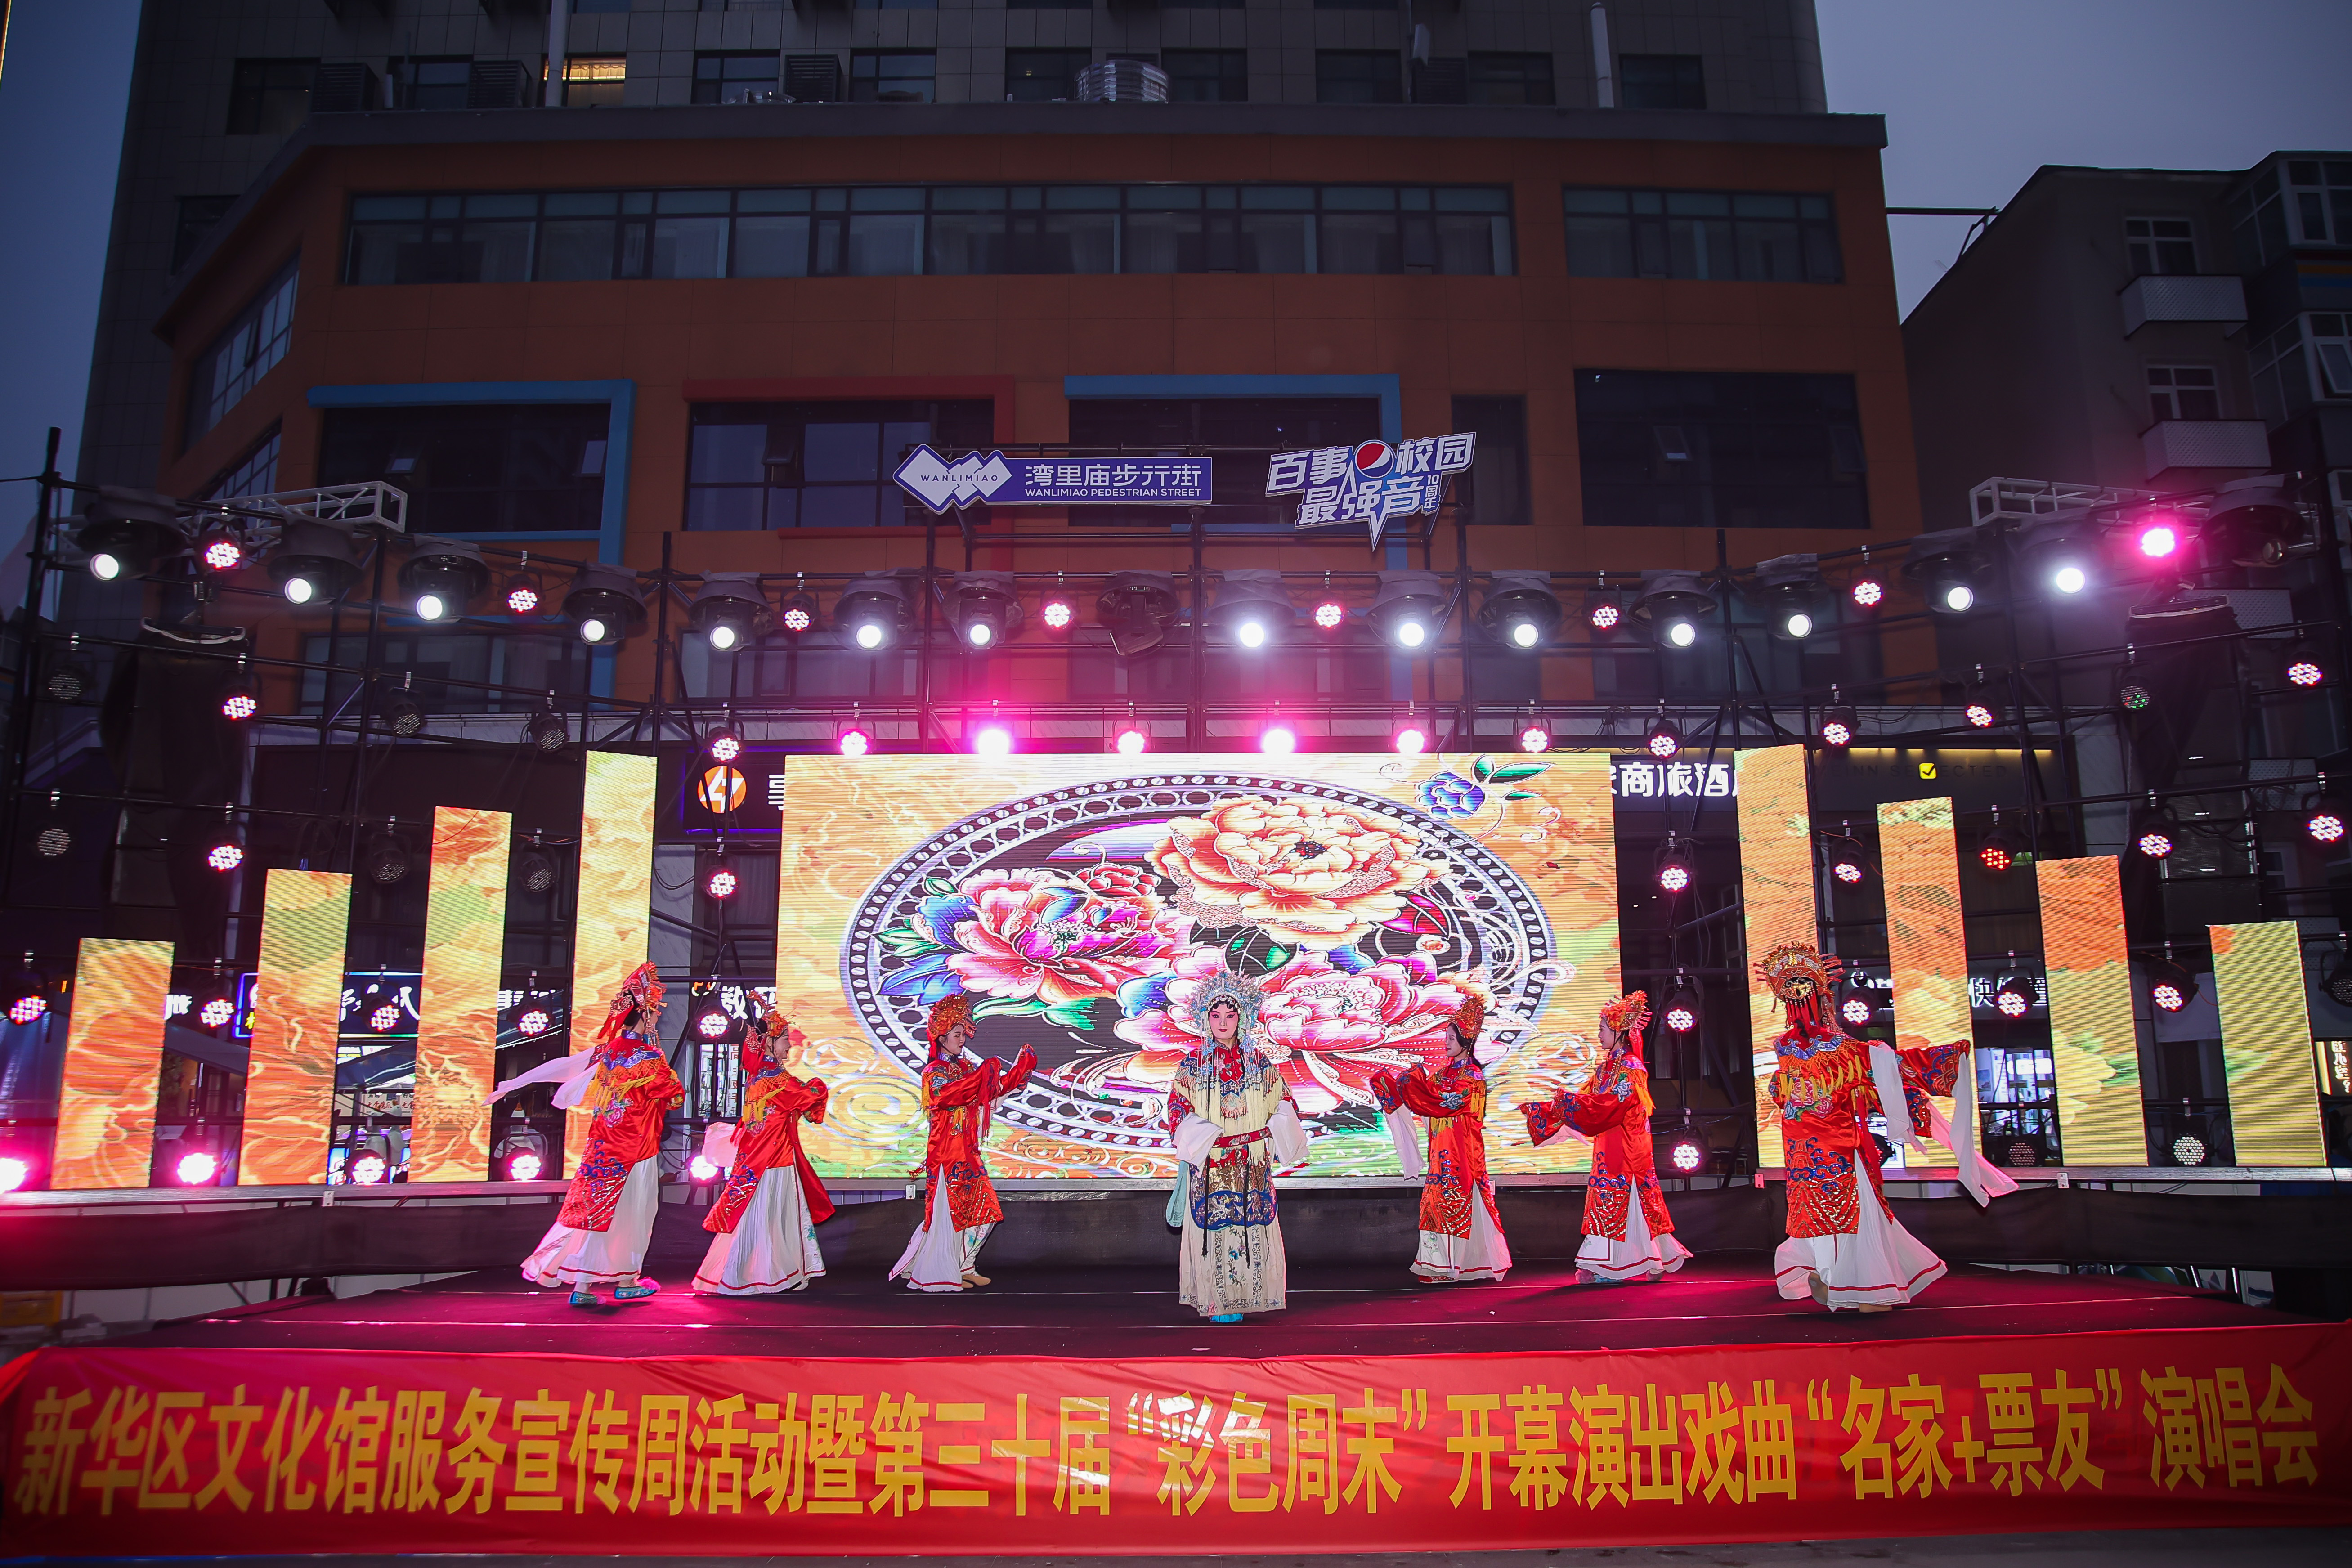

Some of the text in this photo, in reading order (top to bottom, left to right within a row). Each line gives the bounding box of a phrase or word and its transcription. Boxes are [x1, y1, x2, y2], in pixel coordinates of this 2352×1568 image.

[1025, 464, 1201, 487] 湾里庙步行街
[1025, 488, 1201, 497] WANLIMIAO PEDESTRIAN STREET
[1299, 471, 1424, 531] 最强音
[1610, 761, 1738, 797] 商旅酒
